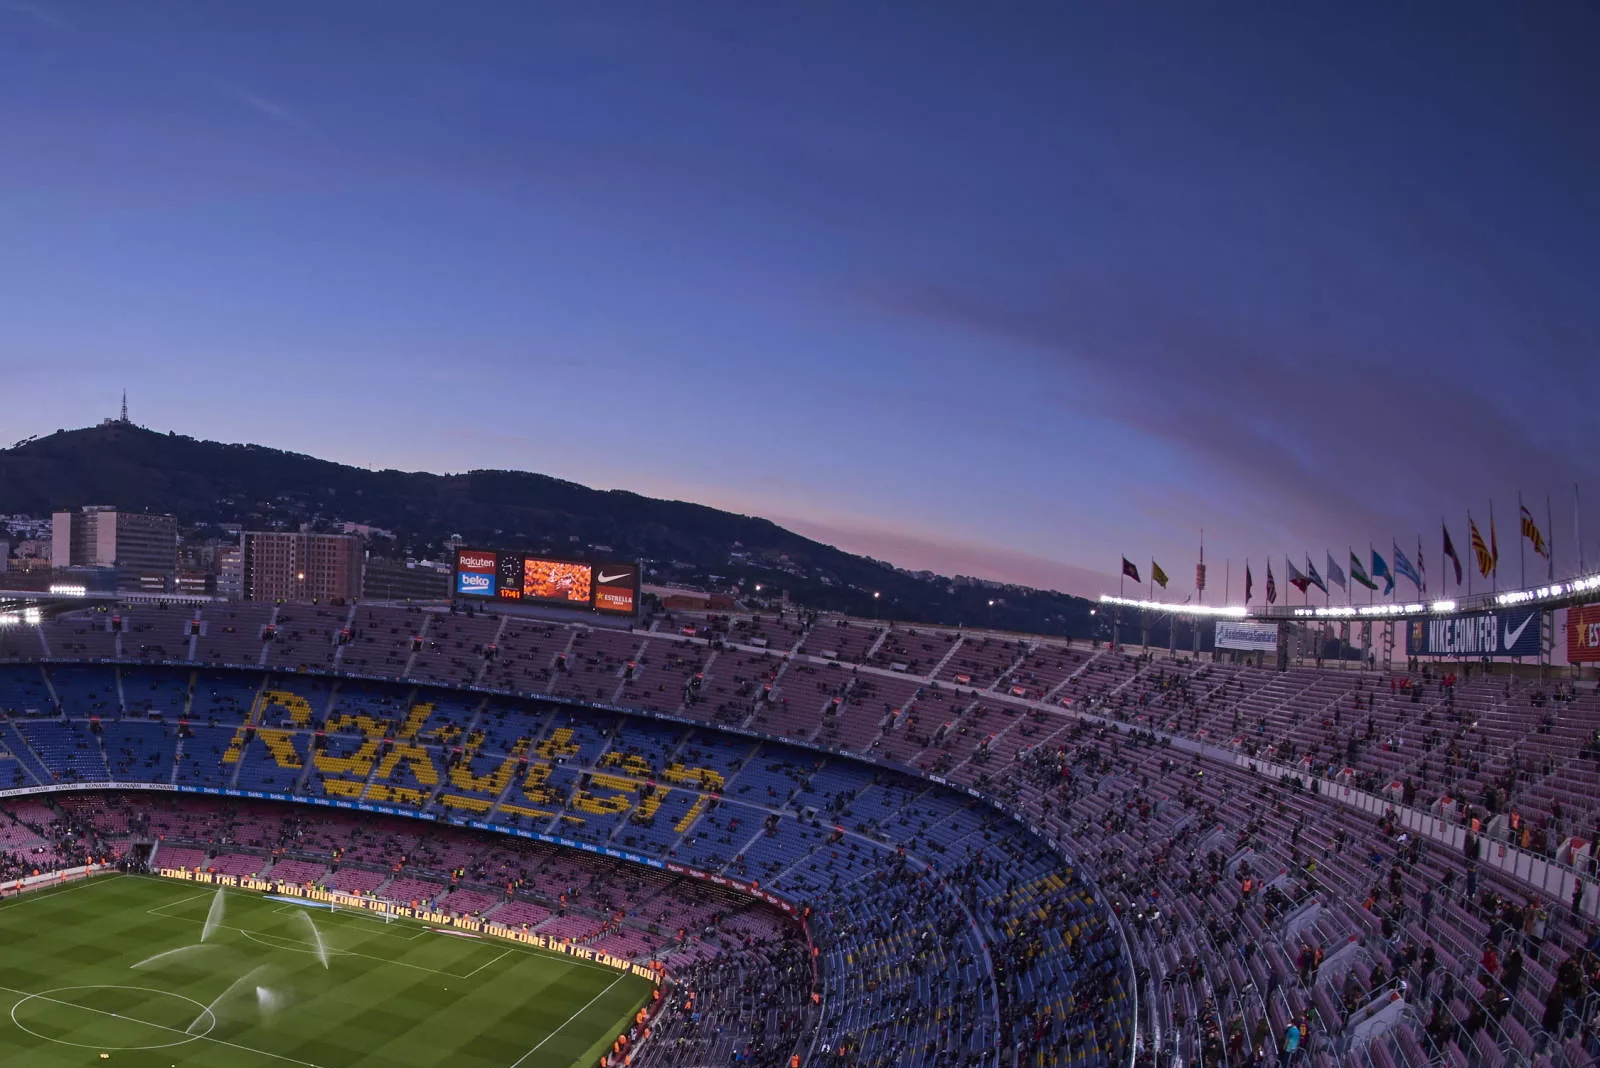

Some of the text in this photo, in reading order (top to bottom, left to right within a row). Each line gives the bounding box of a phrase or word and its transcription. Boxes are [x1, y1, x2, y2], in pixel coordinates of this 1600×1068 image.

[460, 556, 494, 567] Rakuten
[462, 574, 489, 586] beko
[500, 589, 521, 599] 17:41
[1429, 616, 1497, 653] NIKE.COM/FCB
[160, 868, 193, 881] COME
[195, 872, 212, 884] ON
[215, 876, 237, 887] THE
[276, 885, 303, 898] NOU
[333, 894, 366, 908] COME
[368, 900, 386, 912] ON
[389, 906, 412, 919] THE
[415, 910, 451, 926] CAMP
[454, 917, 480, 932] NOU
[483, 924, 514, 939] TOUR
[514, 931, 546, 948] COME
[549, 939, 567, 953] ON
[569, 945, 592, 961] THE
[595, 952, 631, 970] CAMP
[632, 965, 655, 980] NOU
